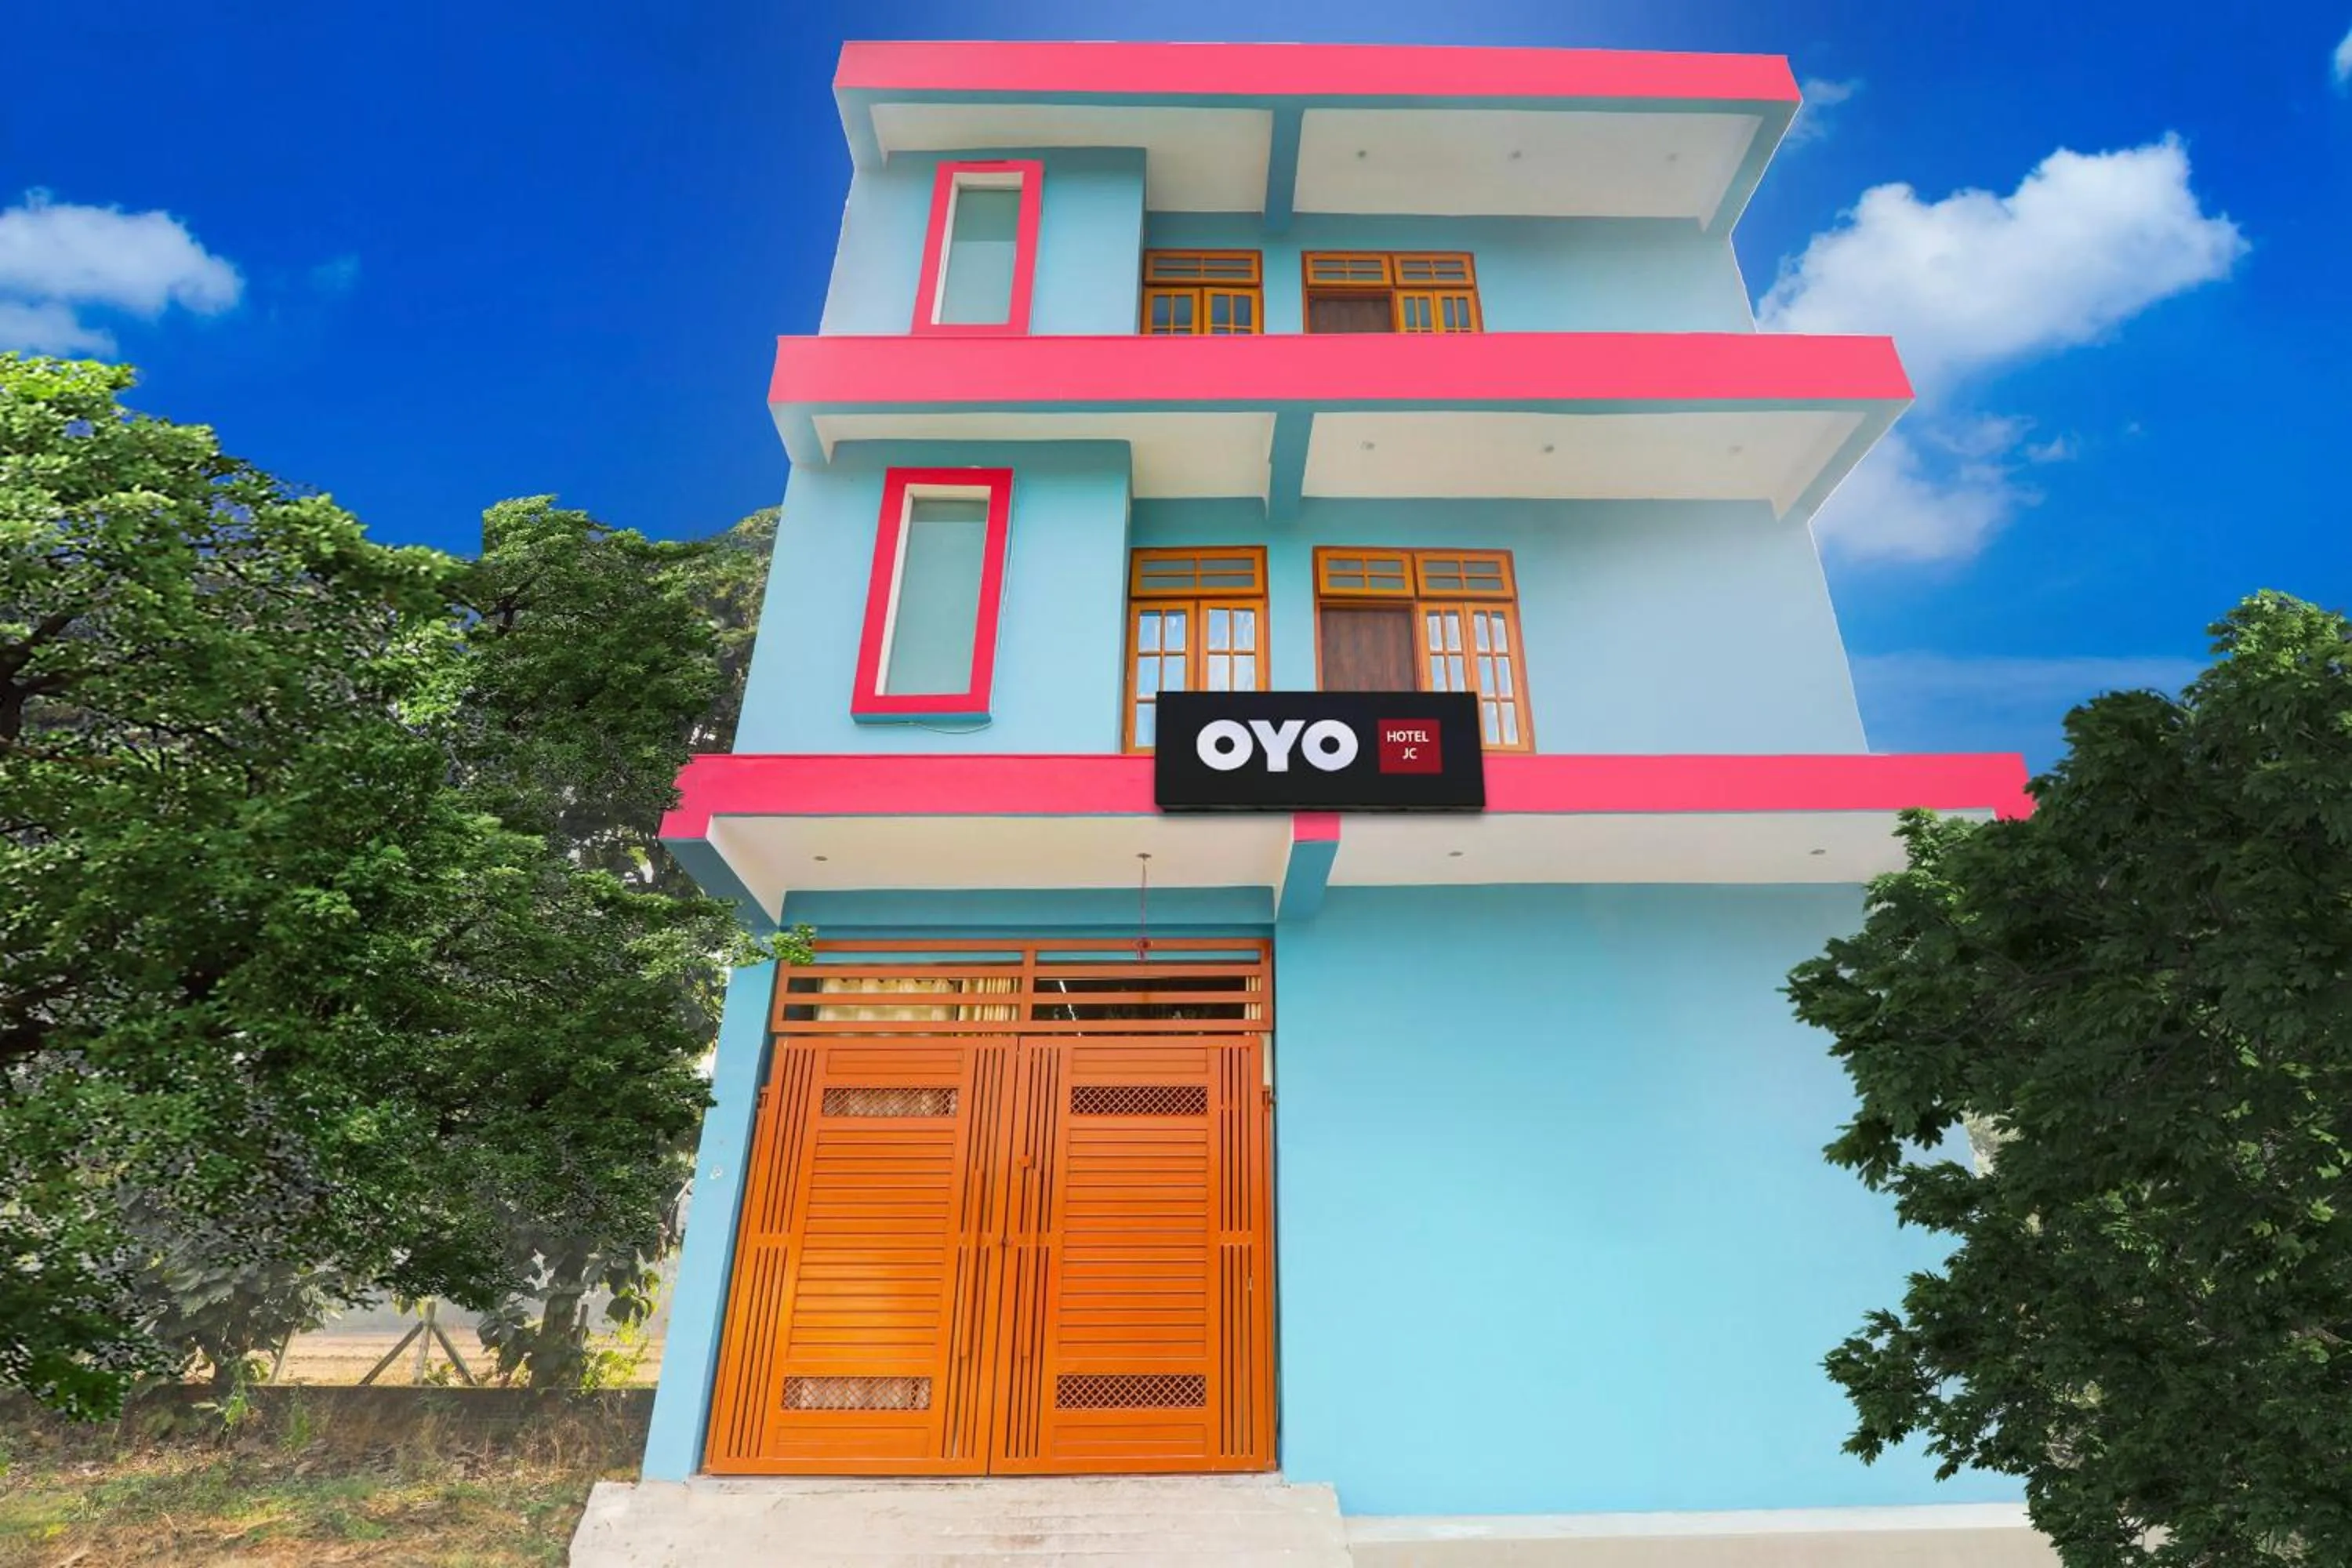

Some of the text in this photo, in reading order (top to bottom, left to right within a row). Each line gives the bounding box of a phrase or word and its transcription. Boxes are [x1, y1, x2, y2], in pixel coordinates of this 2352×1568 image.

[1387, 730, 1429, 742] HOTEL
[1196, 719, 1359, 772] OYO
[1403, 747, 1417, 760] JC
